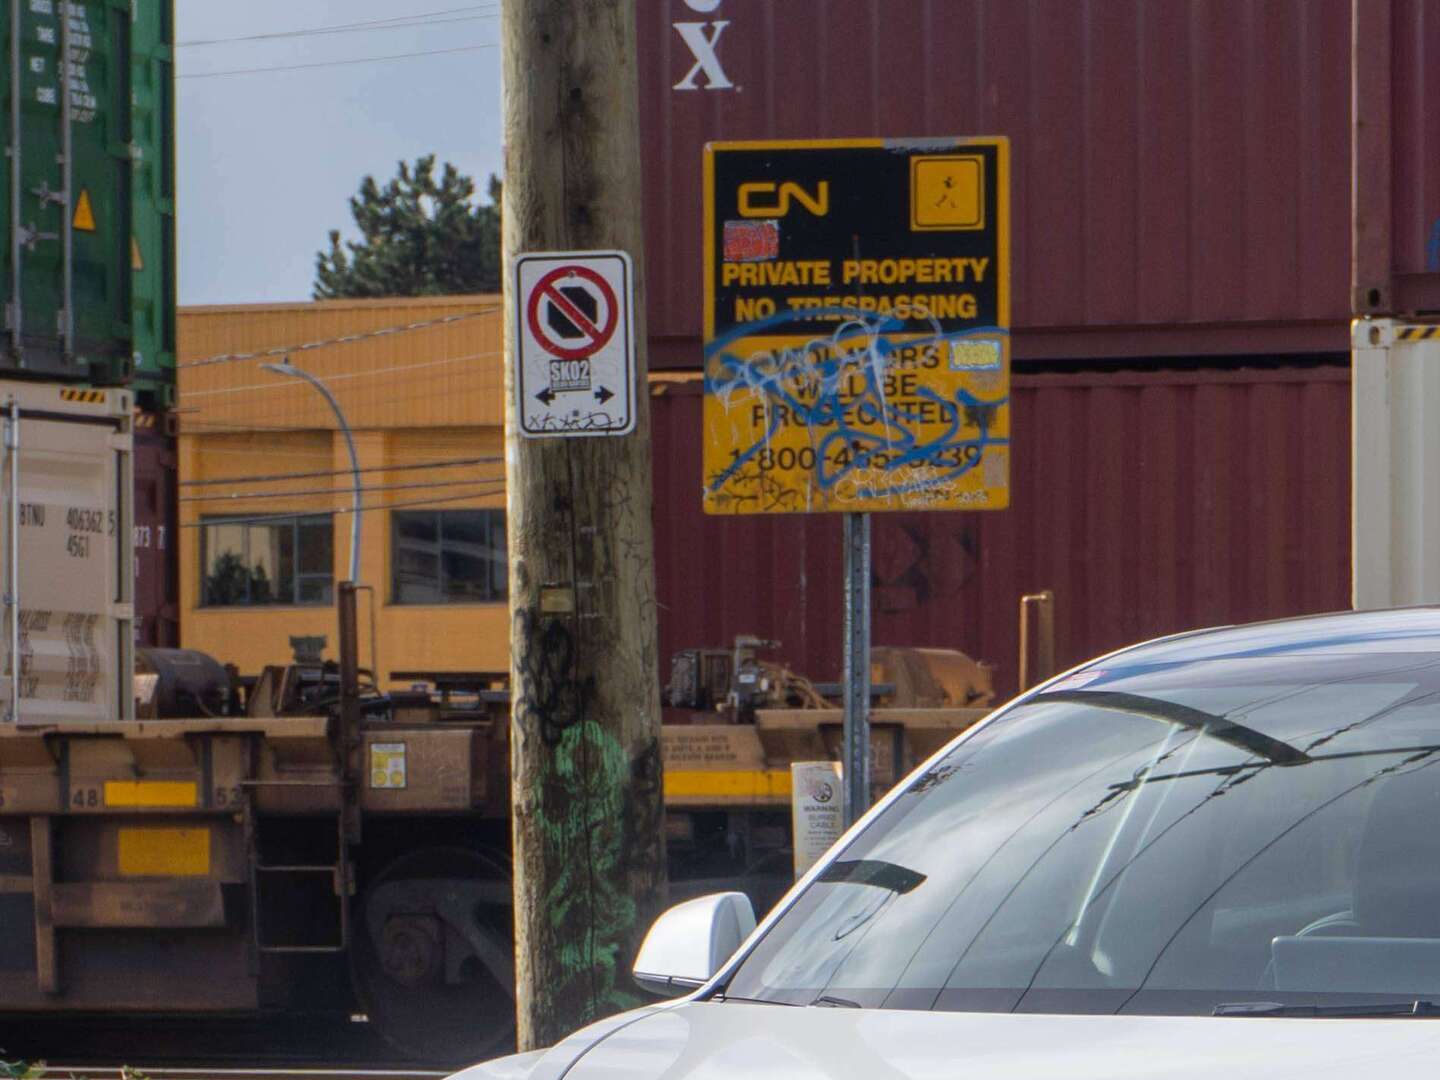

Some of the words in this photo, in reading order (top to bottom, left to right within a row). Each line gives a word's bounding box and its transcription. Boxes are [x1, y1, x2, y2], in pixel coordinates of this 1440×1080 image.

[737, 181, 829, 217] CN
[722, 260, 831, 287] PRIVATE
[843, 257, 989, 284] PROPERTY
[735, 297, 776, 322] NO
[788, 294, 977, 321] TRESPASSING
[793, 375, 862, 399] WLL
[73, 789, 98, 807] 48
